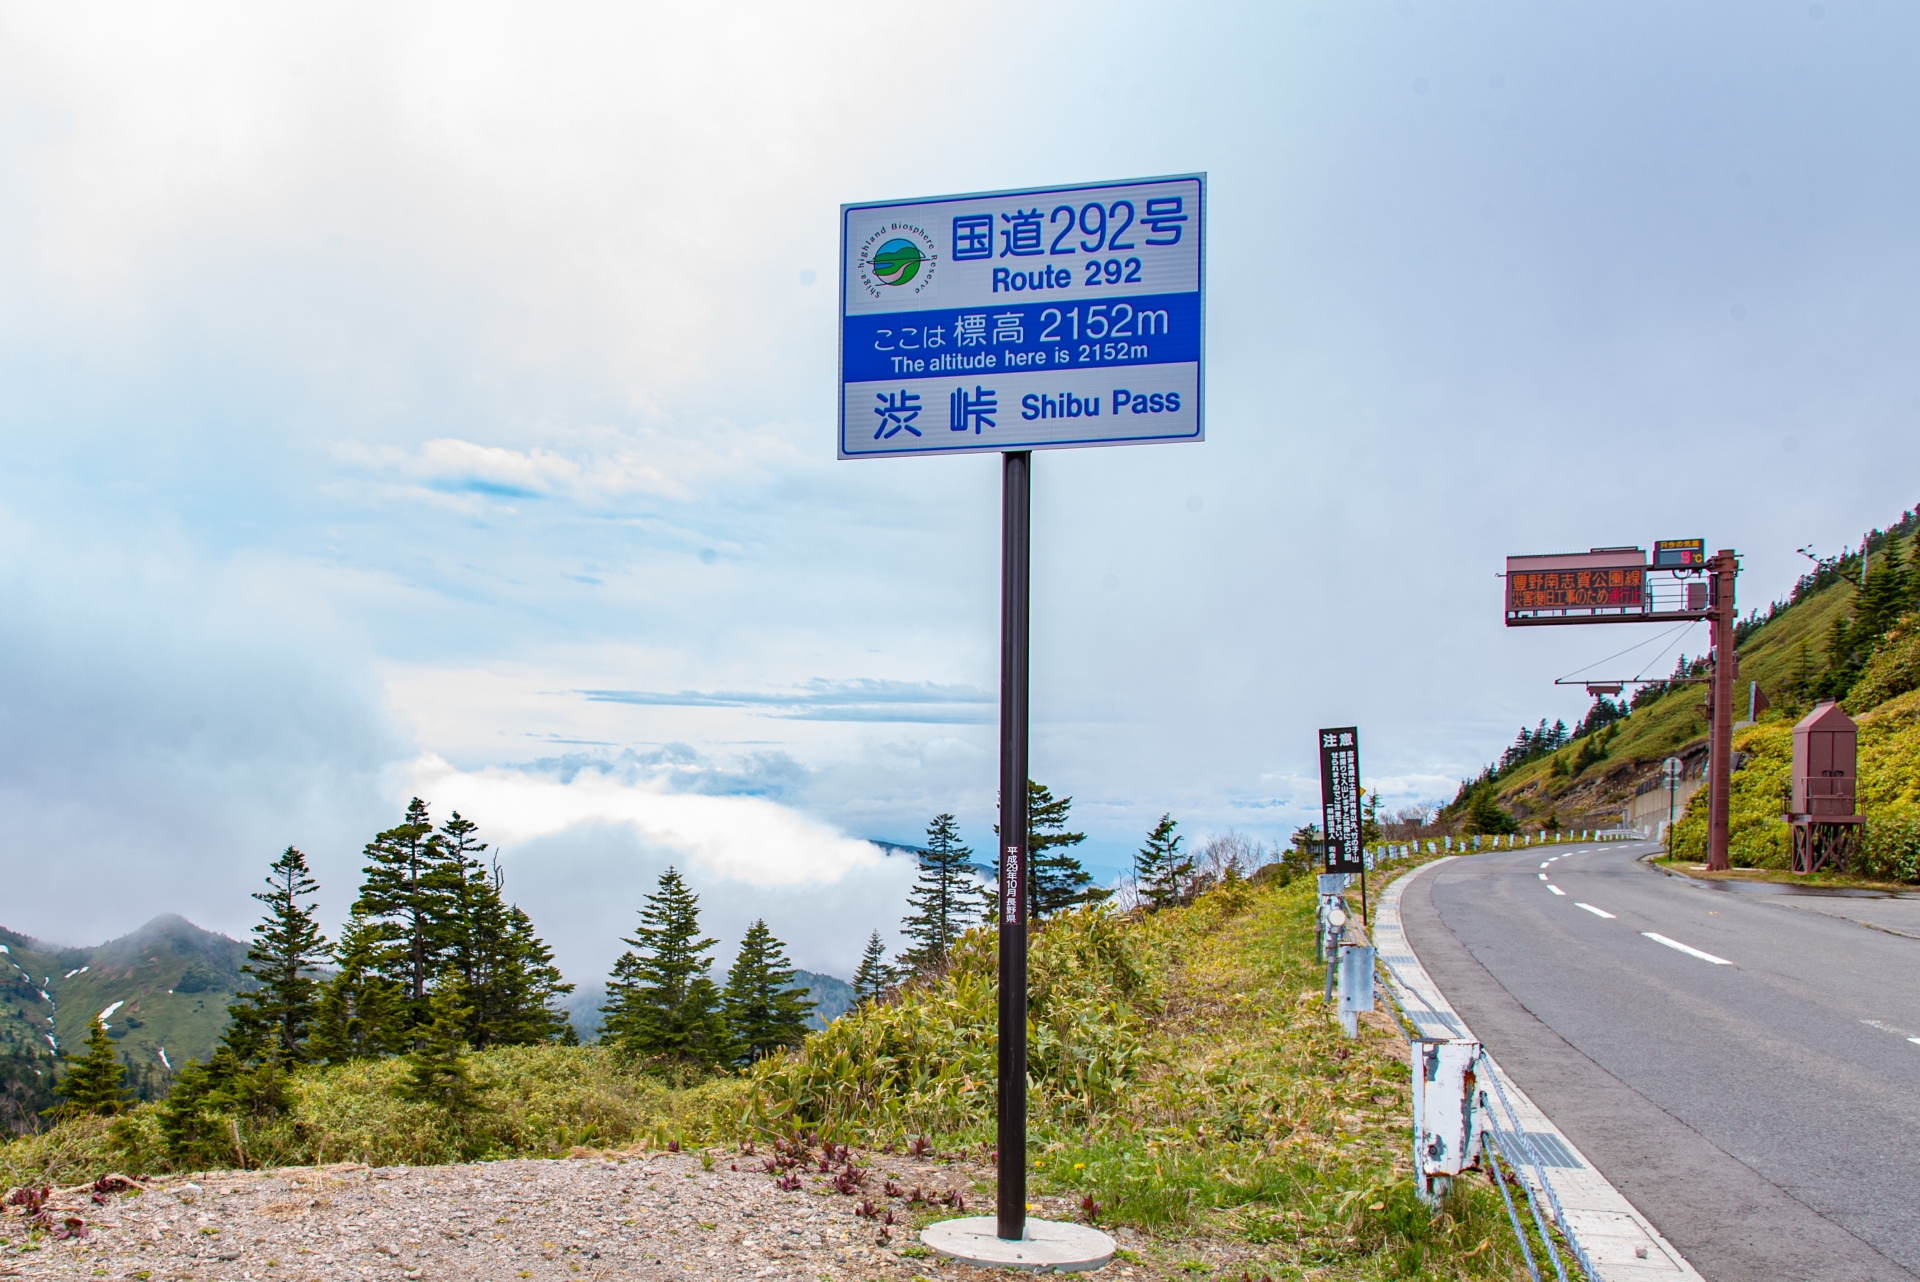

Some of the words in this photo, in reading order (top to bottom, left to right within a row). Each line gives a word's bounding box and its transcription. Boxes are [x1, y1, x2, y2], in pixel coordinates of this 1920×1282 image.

[952, 196, 1189, 261] 国道292号
[891, 221, 936, 250] Biosphere
[914, 254, 938, 294] Reserve
[992, 264, 1072, 293] Route
[1084, 257, 1142, 286] 292
[1039, 302, 1169, 343] 2152m
[891, 355, 924, 374] The
[929, 350, 997, 371] altitude
[1004, 348, 1046, 367] here
[1054, 346, 1070, 364] is
[1078, 341, 1148, 362] 2152m
[1021, 391, 1100, 421] Shibu
[1112, 388, 1181, 415] Pass
[1322, 732, 1354, 748] 注意
